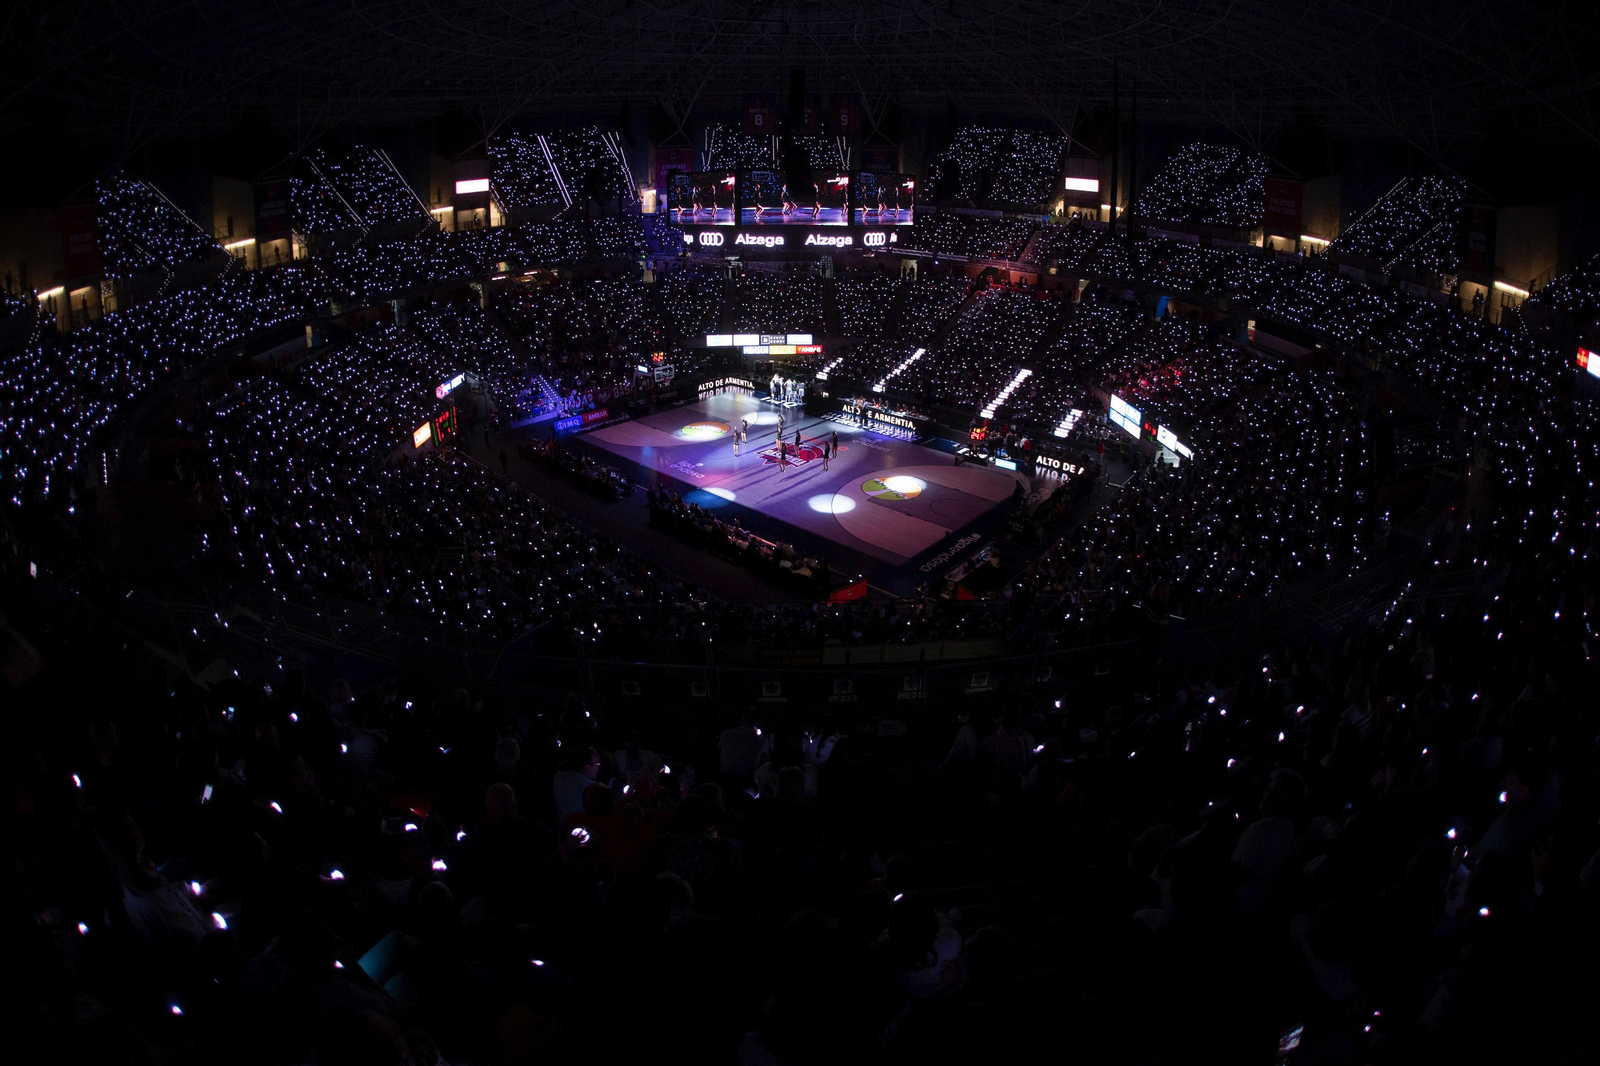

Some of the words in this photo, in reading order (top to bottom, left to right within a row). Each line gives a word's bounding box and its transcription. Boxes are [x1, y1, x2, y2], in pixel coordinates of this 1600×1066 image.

[755, 114, 763, 125] 8
[840, 114, 849, 126] 9
[735, 233, 784, 248] Alzaga
[804, 233, 853, 248] Alzaga
[801, 346, 821, 354] AMBAR
[698, 381, 714, 391] ALTO
[715, 379, 724, 387] DE
[588, 410, 608, 421] AMBAR
[874, 412, 917, 431] ARMENTIA,
[1036, 455, 1061, 469] ALTO
[1062, 462, 1076, 474] DE
